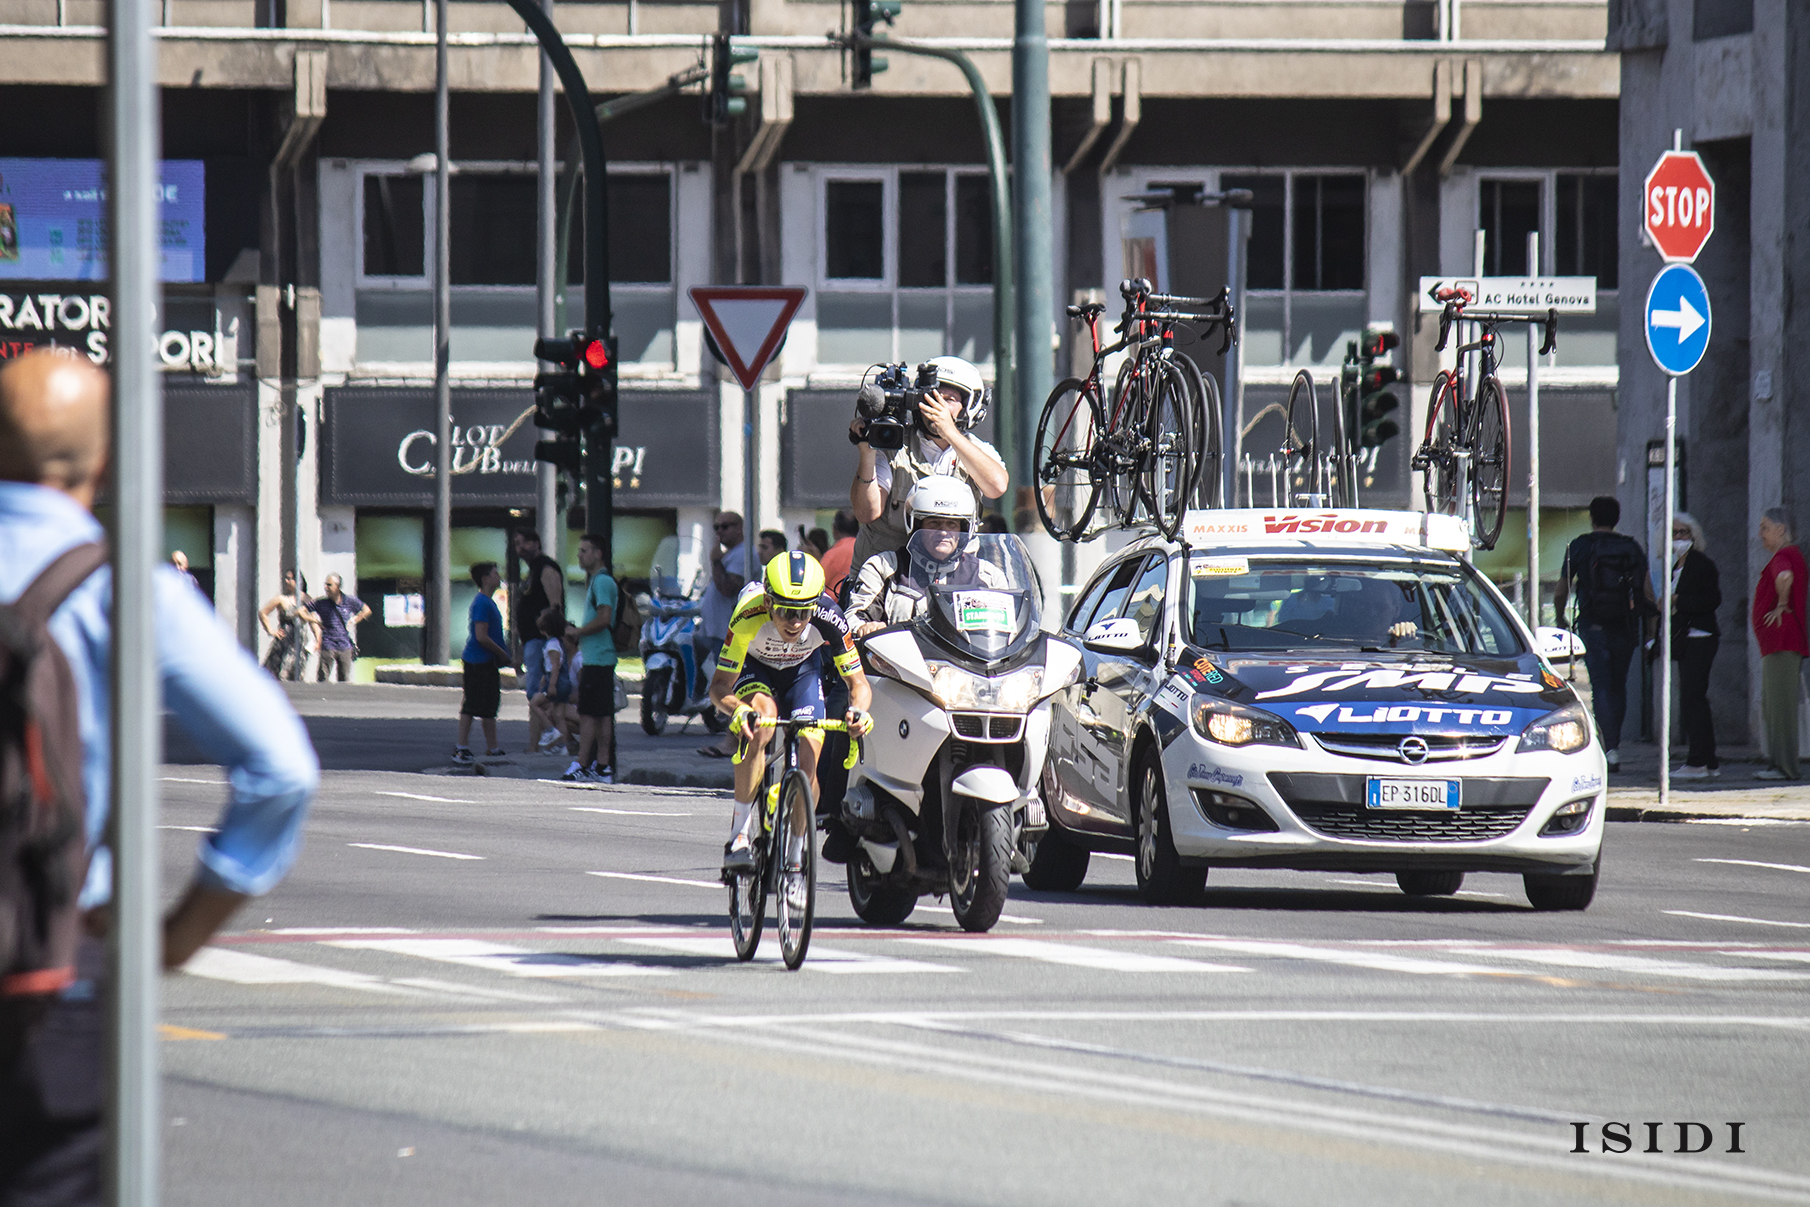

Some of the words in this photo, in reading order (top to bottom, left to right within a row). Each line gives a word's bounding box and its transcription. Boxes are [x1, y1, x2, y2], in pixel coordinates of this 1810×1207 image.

[1650, 185, 1710, 229] STOP
[1484, 294, 1502, 305] AC
[1507, 293, 1541, 305] Hotel
[1545, 294, 1590, 305] Genova
[1193, 524, 1249, 534] MAXXIS
[1264, 513, 1389, 534] Vision
[1382, 785, 1399, 802] EP
[1402, 786, 1447, 804] 316DL
